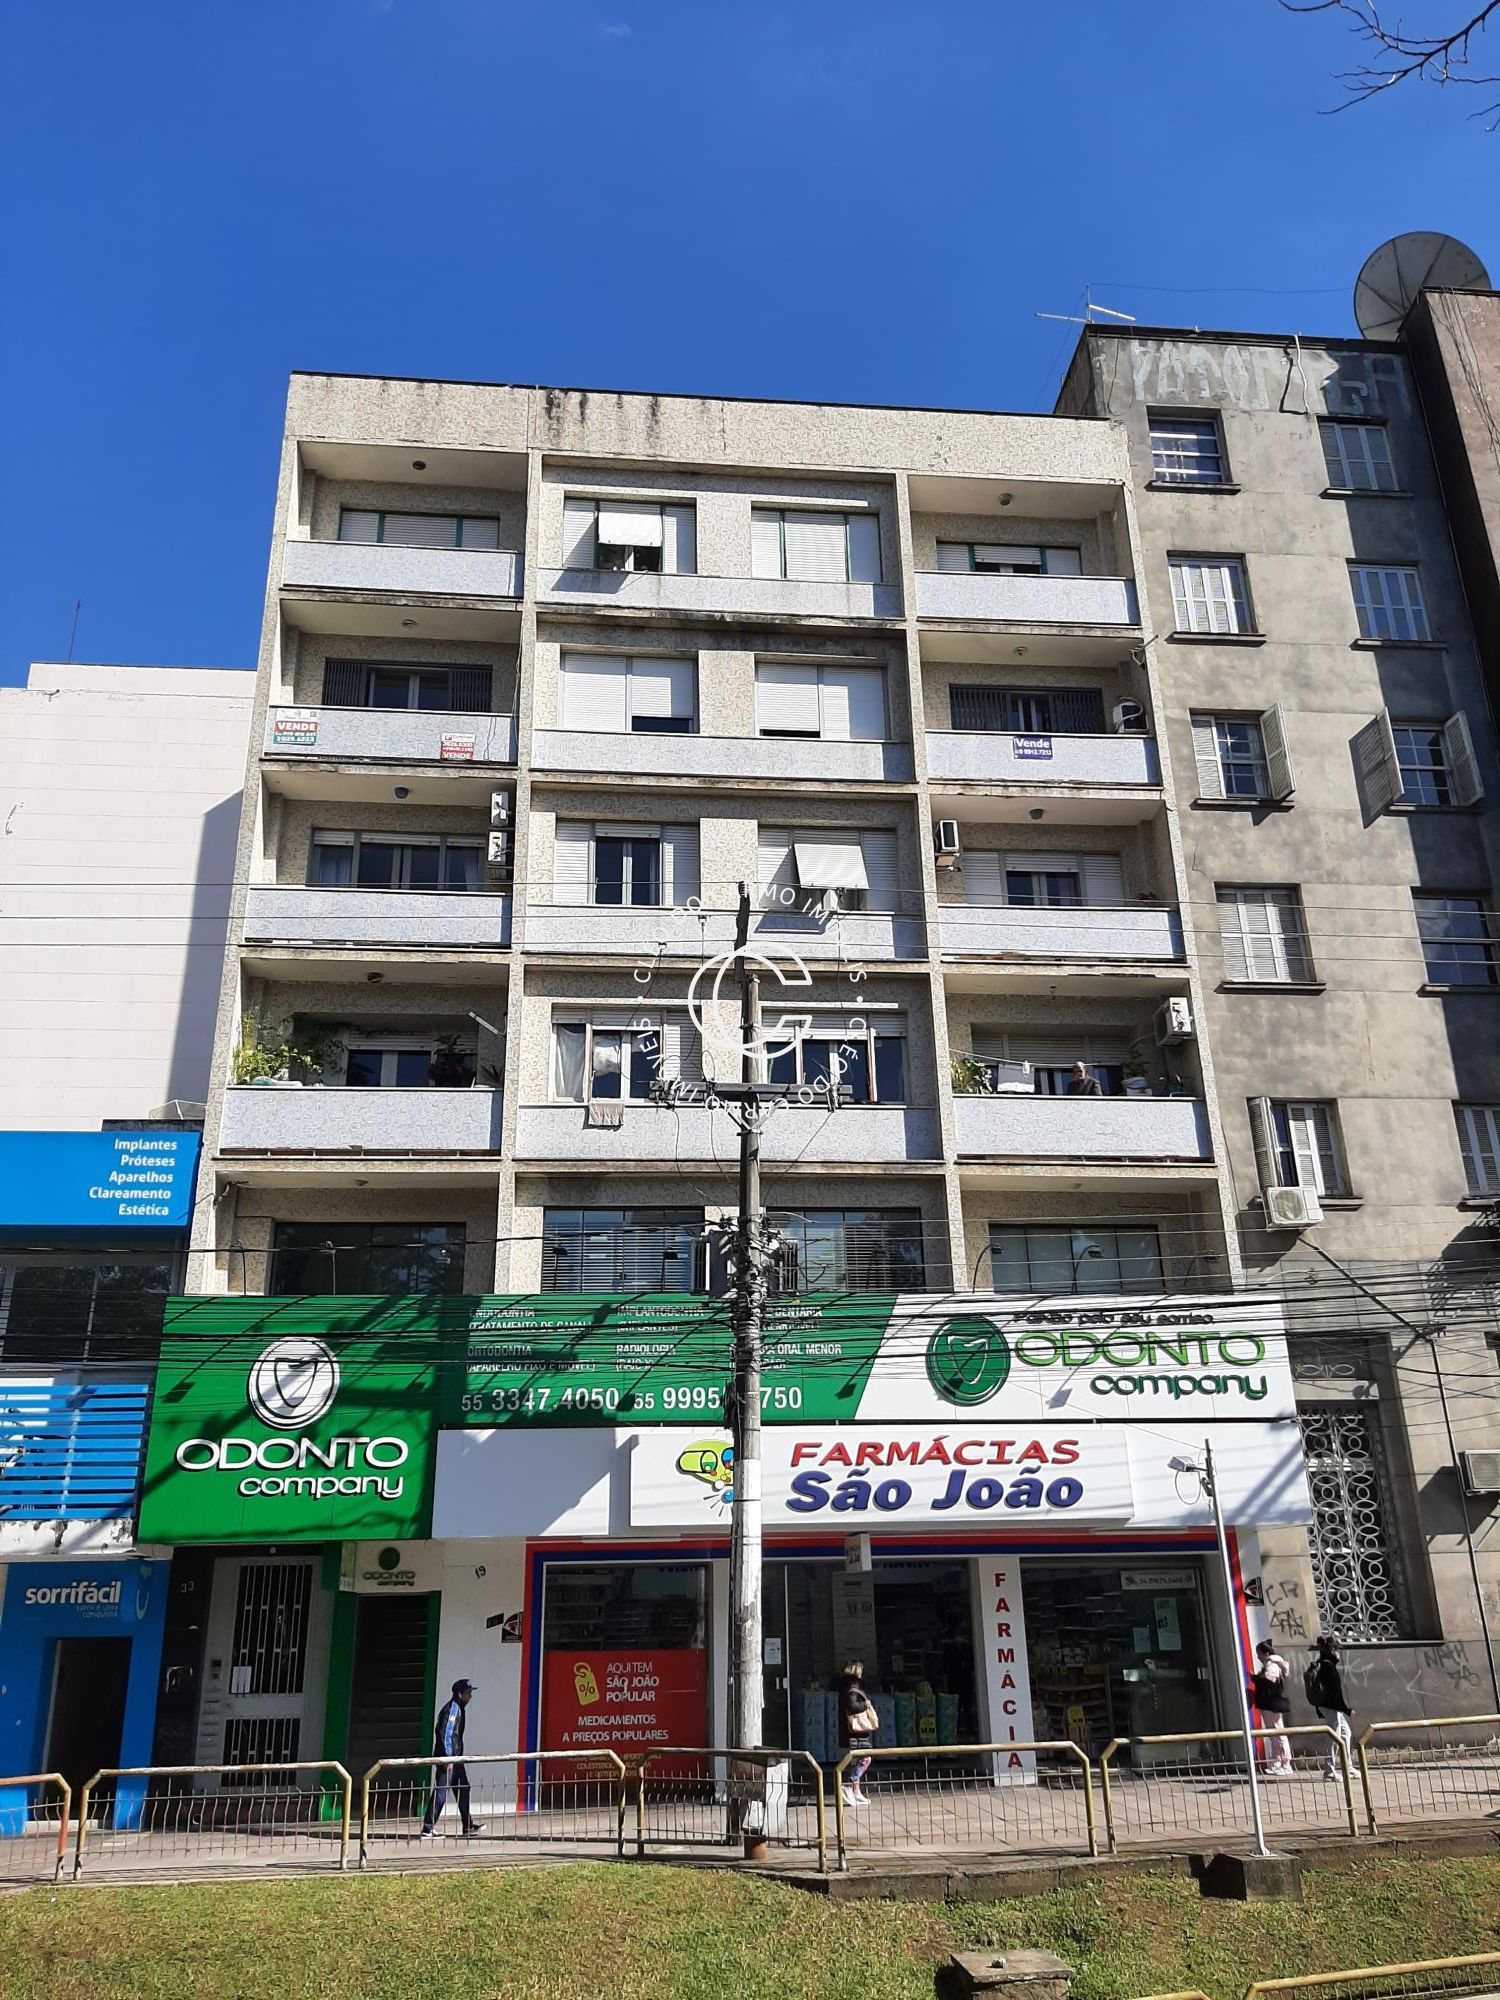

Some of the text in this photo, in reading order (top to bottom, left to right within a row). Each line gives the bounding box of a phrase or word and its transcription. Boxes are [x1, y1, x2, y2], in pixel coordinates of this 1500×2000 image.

[1016, 738, 1050, 748] Vende
[114, 1138, 177, 1153] Implantes
[121, 1154, 176, 1167] Próteses
[109, 1170, 174, 1185] Aparelhos
[89, 1186, 171, 1199] Clareamento
[118, 1203, 169, 1216] Estética
[467, 1345, 532, 1357] ORTODONTIA
[777, 1343, 803, 1355] ORAL
[806, 1343, 841, 1355] MENOR
[1014, 1331, 1266, 1367] ODONTO
[1090, 1373, 1269, 1400] company
[461, 1395, 483, 1411] 55
[491, 1387, 620, 1411] 3347.4050
[633, 1392, 655, 1410] 55
[176, 1436, 409, 1470] ODONTO
[790, 1435, 1081, 1468] FARMÁCIAS
[239, 1476, 404, 1499] company
[785, 1466, 1083, 1513] São João
[363, 1571, 415, 1580] ODONTO
[474, 1566, 487, 1579] 19
[25, 1580, 121, 1605] sorrifácil
[606, 1662, 653, 1675] AQUI TEM
[994, 1573, 1023, 1768] FARMÁCIA
[606, 1675, 660, 1689] SÃO JOÃO
[606, 1691, 656, 1702] POPULAR
[578, 1714, 657, 1726] MEDICAMENTOS
[562, 1729, 669, 1744] A PREÇOS POPULARES
